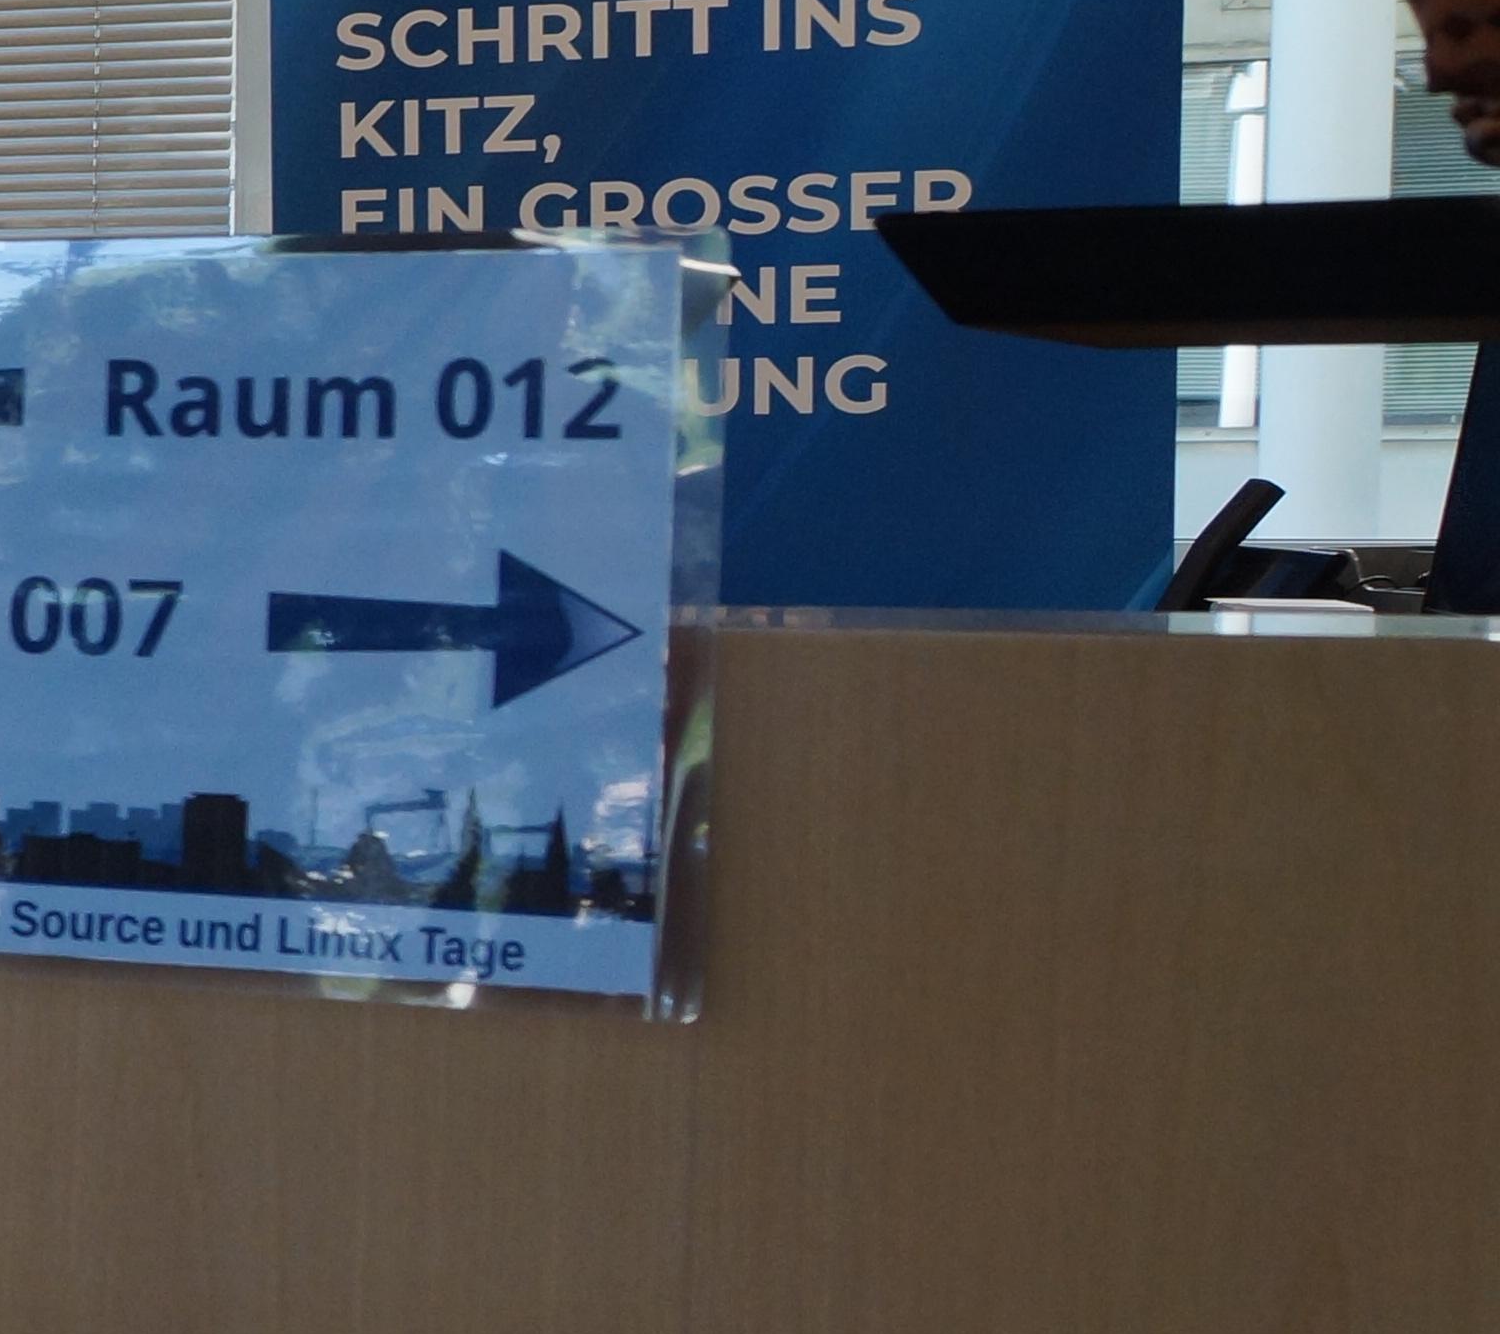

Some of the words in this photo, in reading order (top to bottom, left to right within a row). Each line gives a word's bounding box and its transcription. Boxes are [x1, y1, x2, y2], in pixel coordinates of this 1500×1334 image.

[339, 94, 562, 165] KITZ,
[106, 357, 397, 440] Raum
[434, 357, 622, 441] 012
[10, 577, 185, 657] 007
[10, 898, 166, 947] Source
[177, 908, 261, 955] und
[419, 926, 526, 979] Tage
